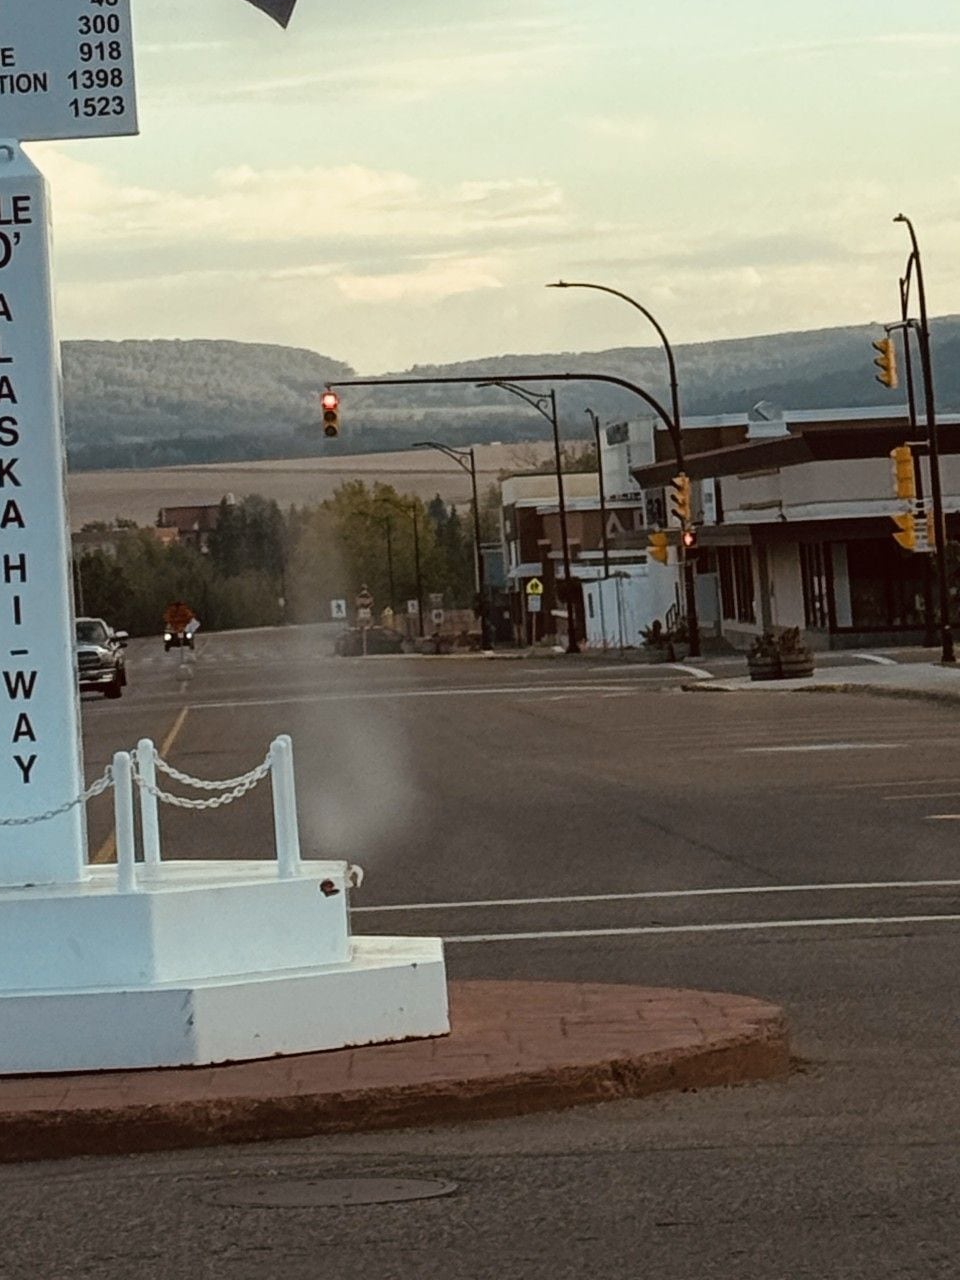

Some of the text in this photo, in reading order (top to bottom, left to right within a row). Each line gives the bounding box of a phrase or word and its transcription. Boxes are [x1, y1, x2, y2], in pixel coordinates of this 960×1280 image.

[77, 13, 120, 36] 300
[79, 40, 122, 63] 918
[67, 67, 124, 91] 1398
[68, 95, 125, 118] 1523
